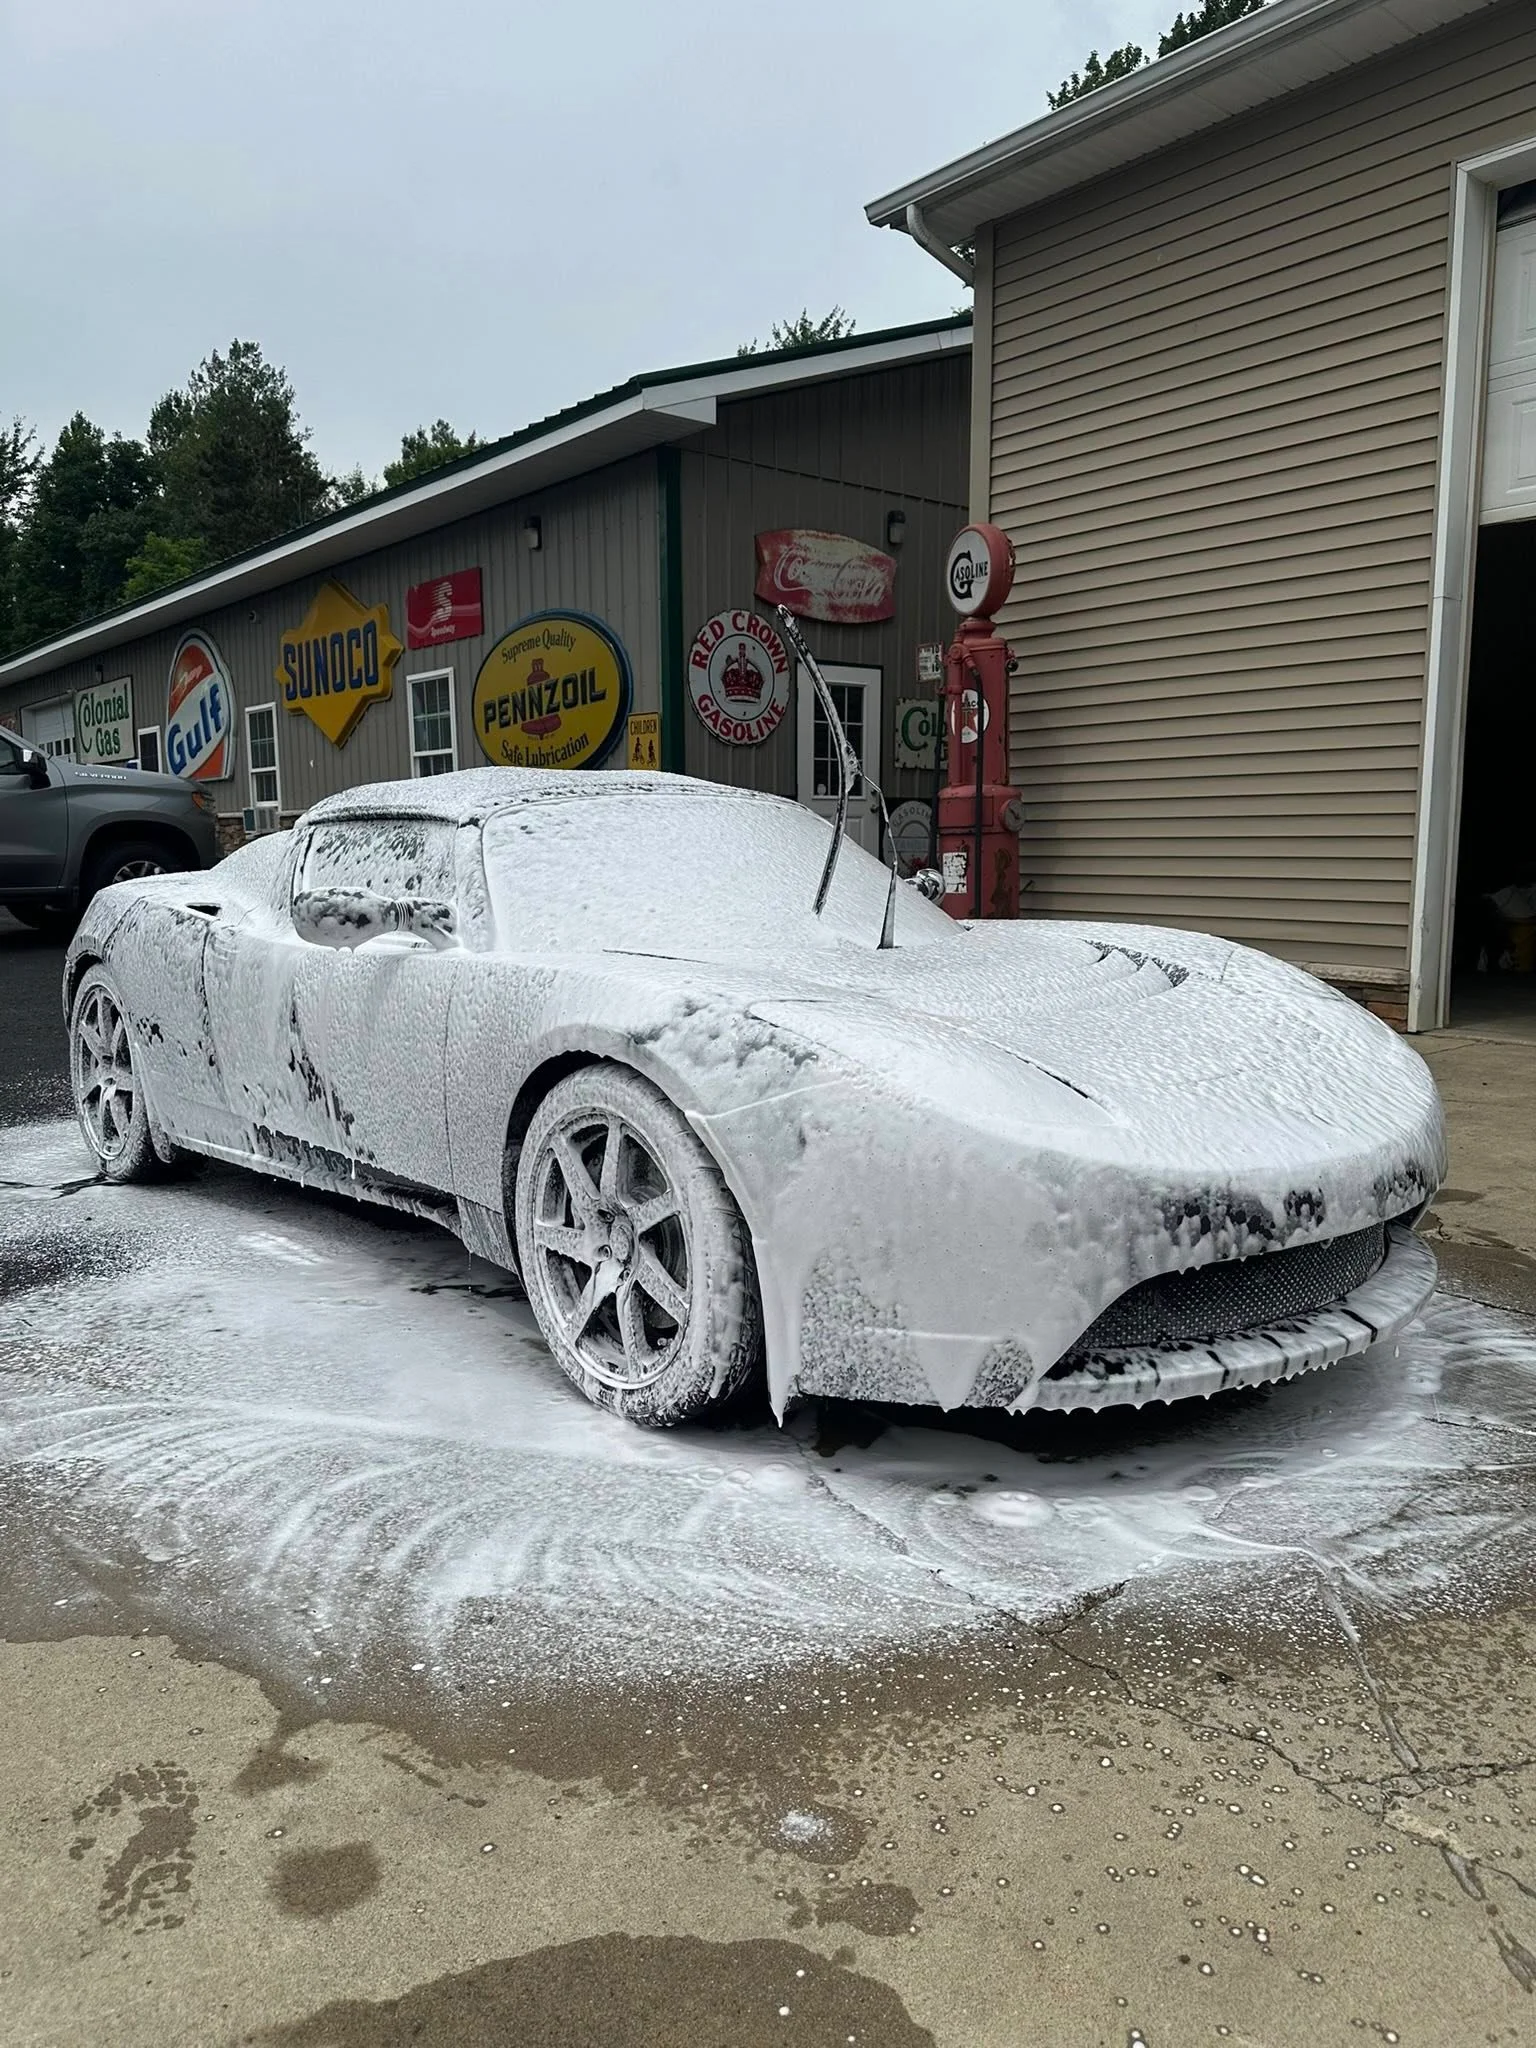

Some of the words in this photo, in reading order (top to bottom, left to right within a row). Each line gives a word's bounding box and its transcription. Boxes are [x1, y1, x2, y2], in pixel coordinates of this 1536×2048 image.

[774, 546, 887, 603] CoCola
[950, 550, 989, 600] GASOLINE
[282, 619, 379, 701] SUNOCO
[501, 634, 541, 665] Supreme
[542, 628, 577, 653] Quality
[691, 619, 726, 671] RED
[731, 612, 789, 675] CROWN
[79, 683, 130, 754] Colonial
[483, 667, 608, 734] PENNZOIL
[697, 693, 785, 741] GASOLINE
[95, 727, 121, 757] Gas
[167, 683, 222, 776] Gulf
[501, 739, 524, 765] Safe
[525, 732, 590, 767] Lubrication
[630, 719, 657, 736] CHILDREN
[892, 806, 931, 828] GASOLIN
